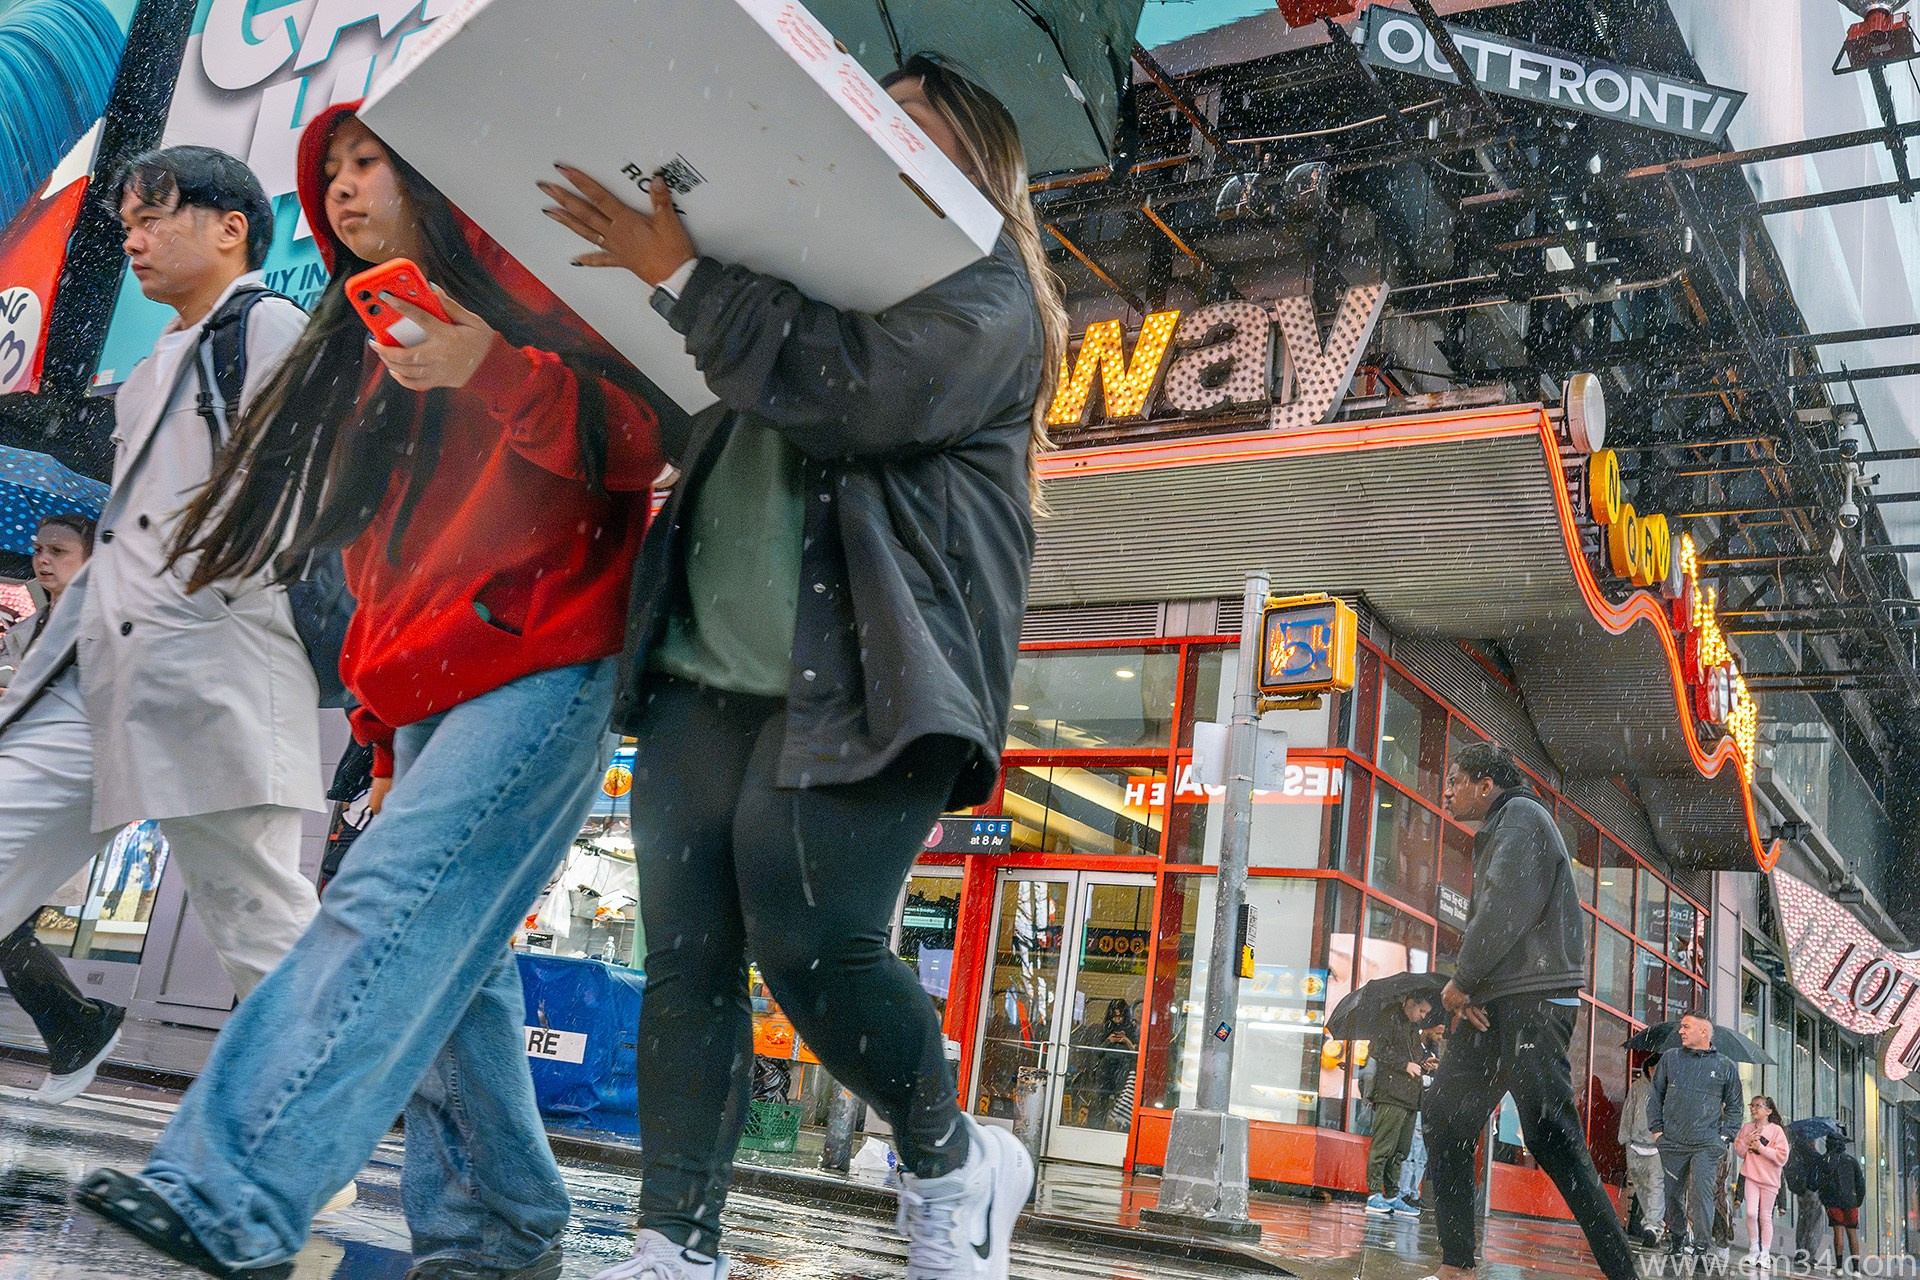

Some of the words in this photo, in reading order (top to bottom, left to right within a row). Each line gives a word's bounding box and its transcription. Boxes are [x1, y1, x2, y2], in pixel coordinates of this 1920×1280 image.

[1046, 281, 1388, 429] way
[970, 835, 981, 846] at
[981, 835, 990, 846] 8
[991, 835, 1004, 846] Av
[528, 1030, 560, 1055] RE
